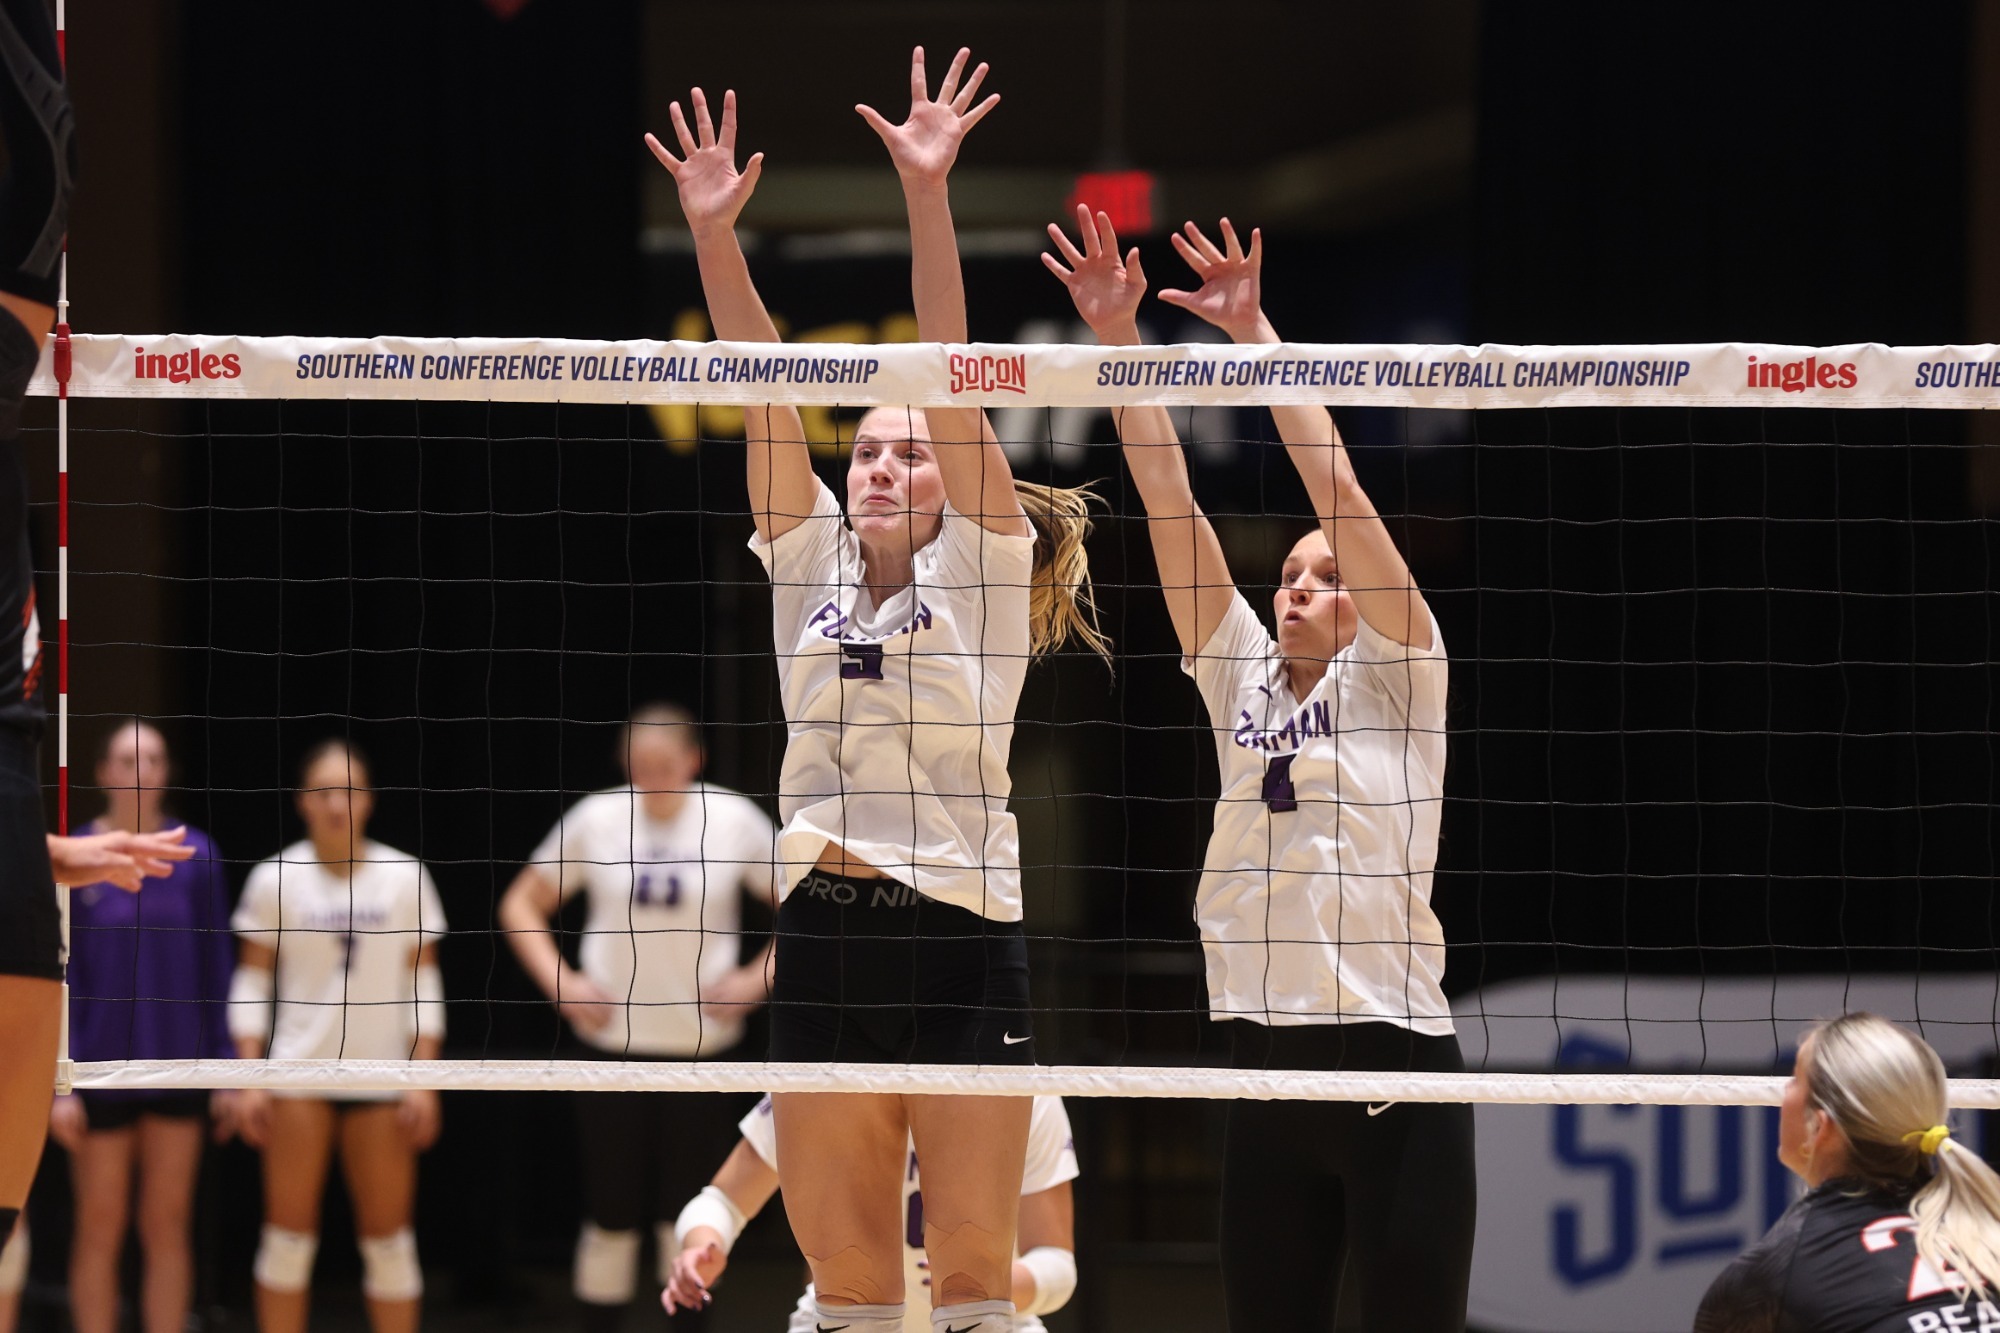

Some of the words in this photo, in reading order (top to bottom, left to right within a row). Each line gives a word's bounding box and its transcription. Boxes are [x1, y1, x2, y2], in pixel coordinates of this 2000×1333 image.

[134, 346, 242, 384] ingles
[296, 354, 415, 380] SOUTHERN
[420, 355, 565, 381] CONFERENCE
[570, 355, 701, 382] VOLLEYBALL
[706, 357, 879, 384] CHAMPIONSHIP
[1097, 360, 1216, 386] SOUTHERN
[1220, 360, 1370, 386] CONFERENCE
[1374, 360, 1507, 387] VOLLEYBALL
[1512, 360, 1691, 387] CHAMPIONSHIP
[1747, 355, 1858, 393] ingles
